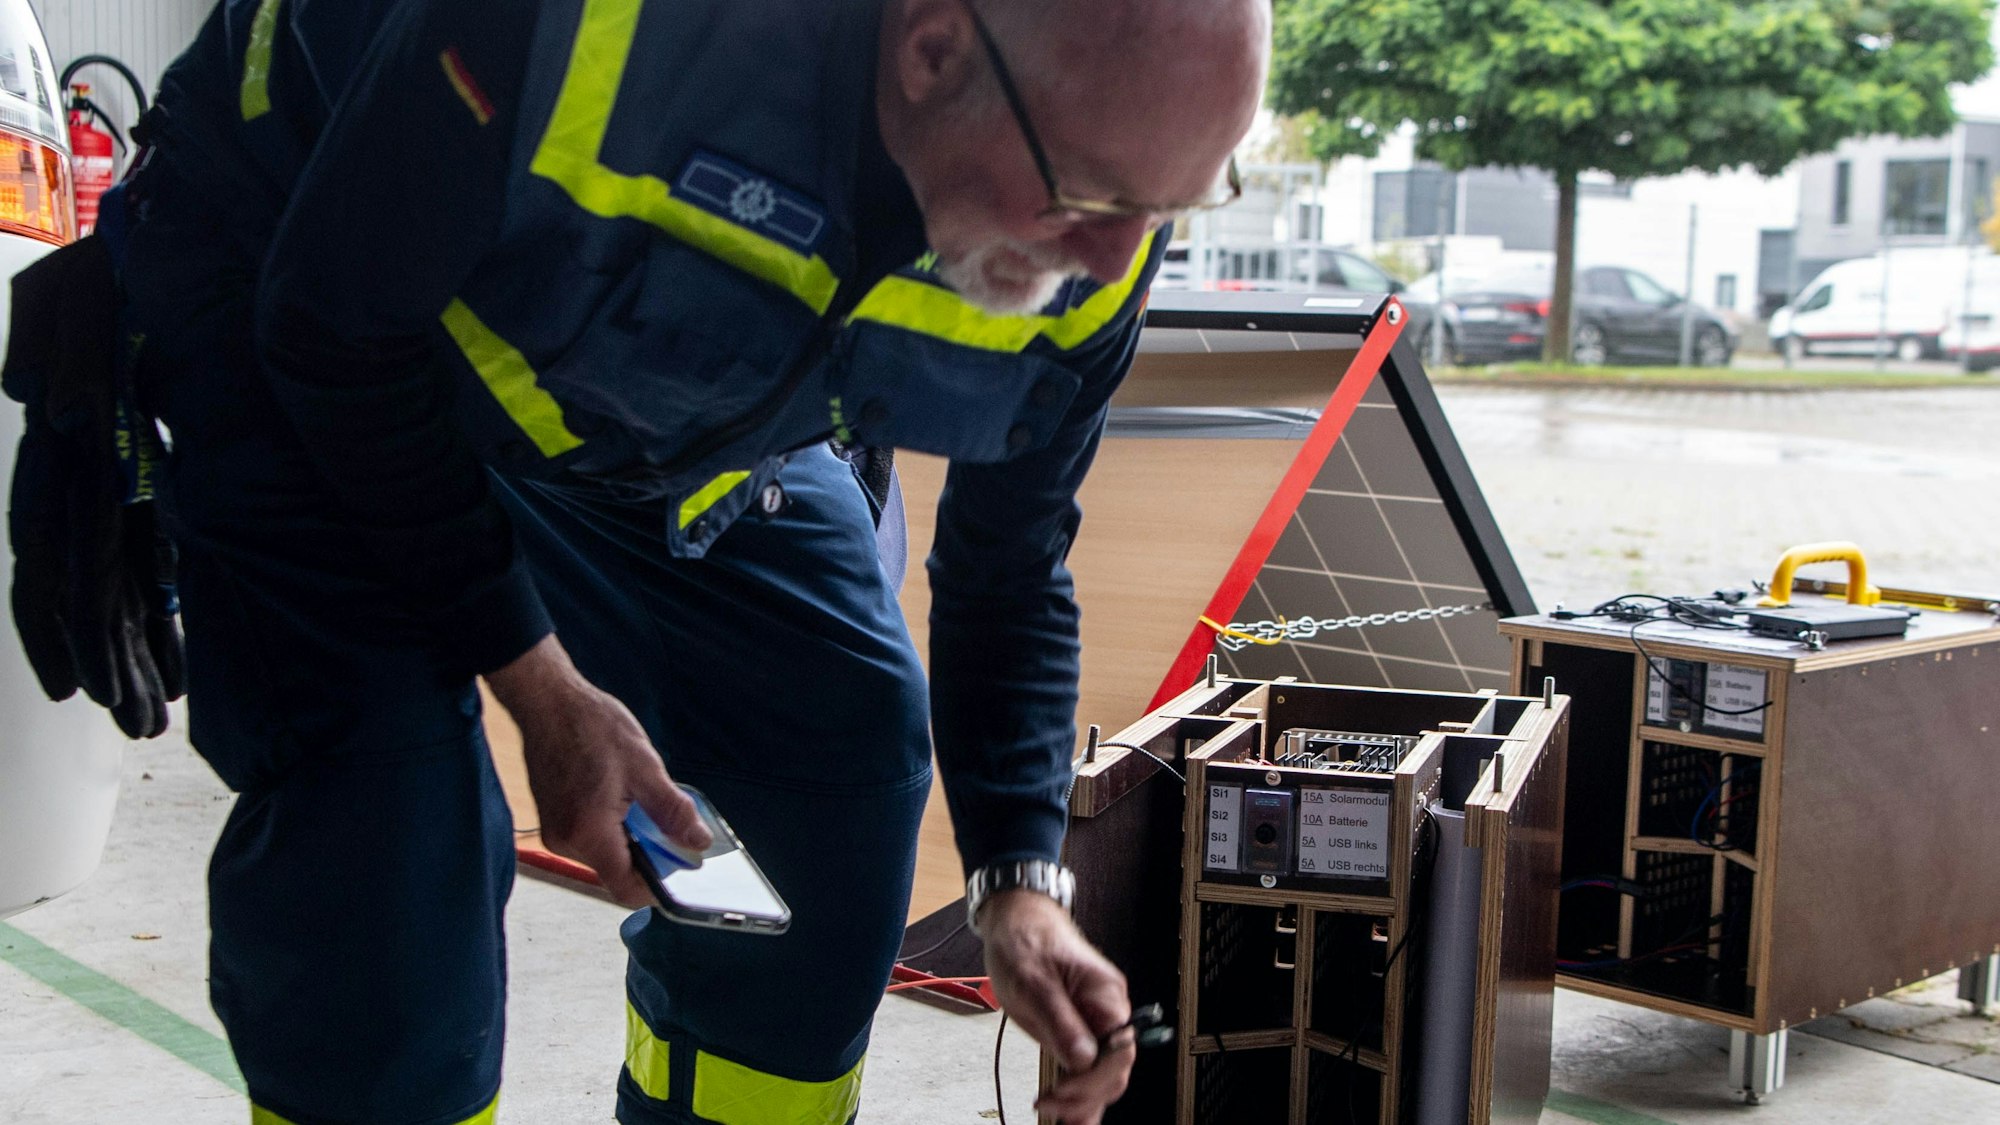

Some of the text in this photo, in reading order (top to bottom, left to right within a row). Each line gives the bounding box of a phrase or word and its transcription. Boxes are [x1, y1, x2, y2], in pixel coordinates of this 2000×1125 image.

[1212, 788, 1229, 798] Si1
[1304, 792, 1388, 806] 15A Solarmodul
[1211, 810, 1229, 821] Si2
[1302, 814, 1369, 827] 10A Batterie
[1210, 832, 1228, 842] Si3
[1301, 836, 1378, 850] 5A USB links
[1209, 854, 1227, 864] Si4
[1301, 858, 1385, 873] 5A USB rechts
